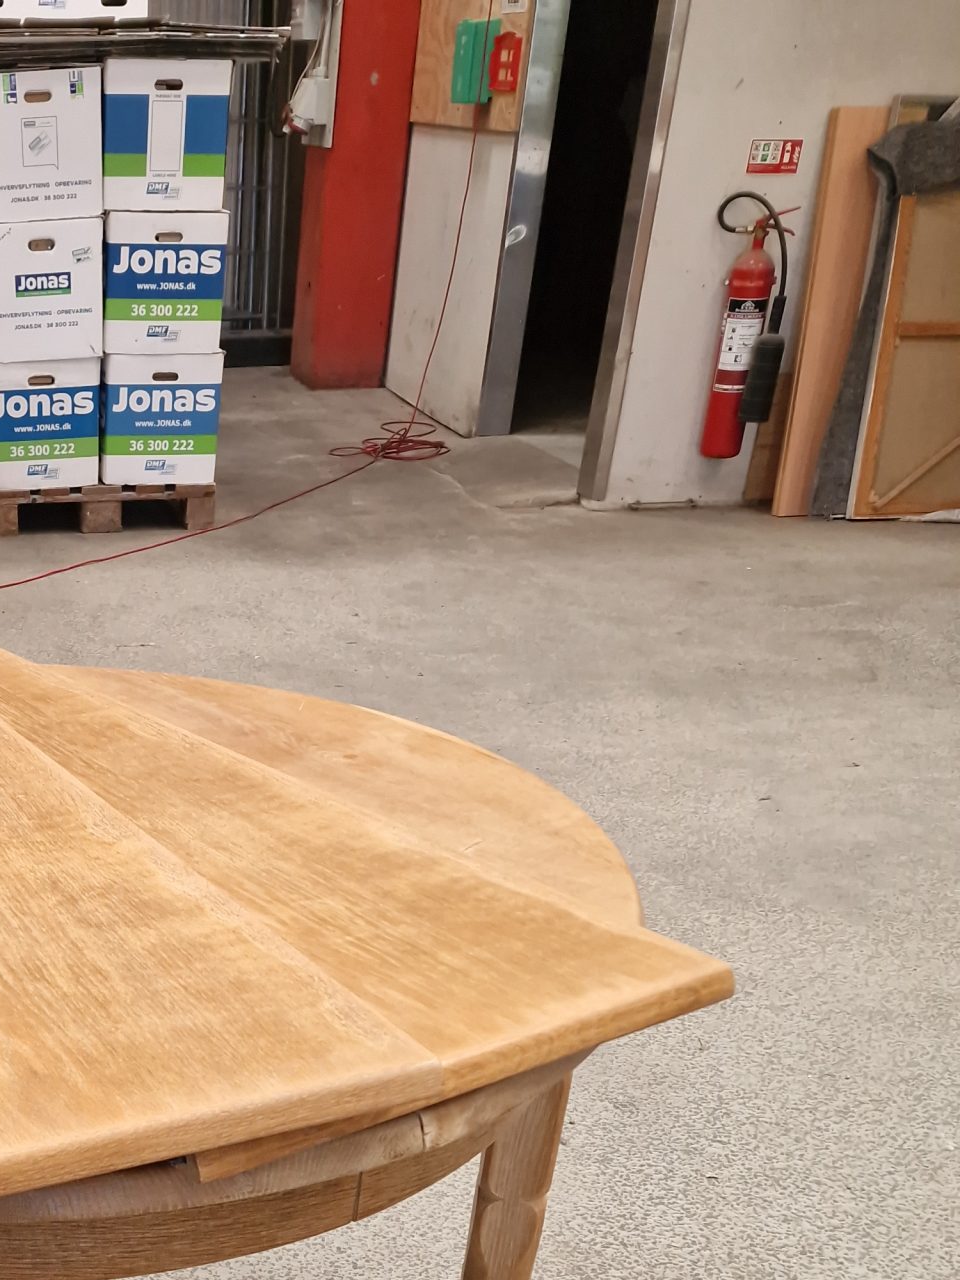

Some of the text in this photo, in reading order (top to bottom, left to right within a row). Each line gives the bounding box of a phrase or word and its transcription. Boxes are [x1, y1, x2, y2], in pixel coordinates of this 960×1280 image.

[112, 246, 222, 275] Jonas
[17, 274, 69, 291] Jonas
[136, 282, 196, 290] www.JONAS.dk
[131, 304, 198, 316] 36 300 222
[112, 386, 216, 412] Jonas
[14, 423, 72, 433] www.JONAS.dk
[135, 419, 192, 427] www.JONAS.dk
[10, 443, 75, 457] 36 300 222
[129, 439, 194, 451] 36 300 222
